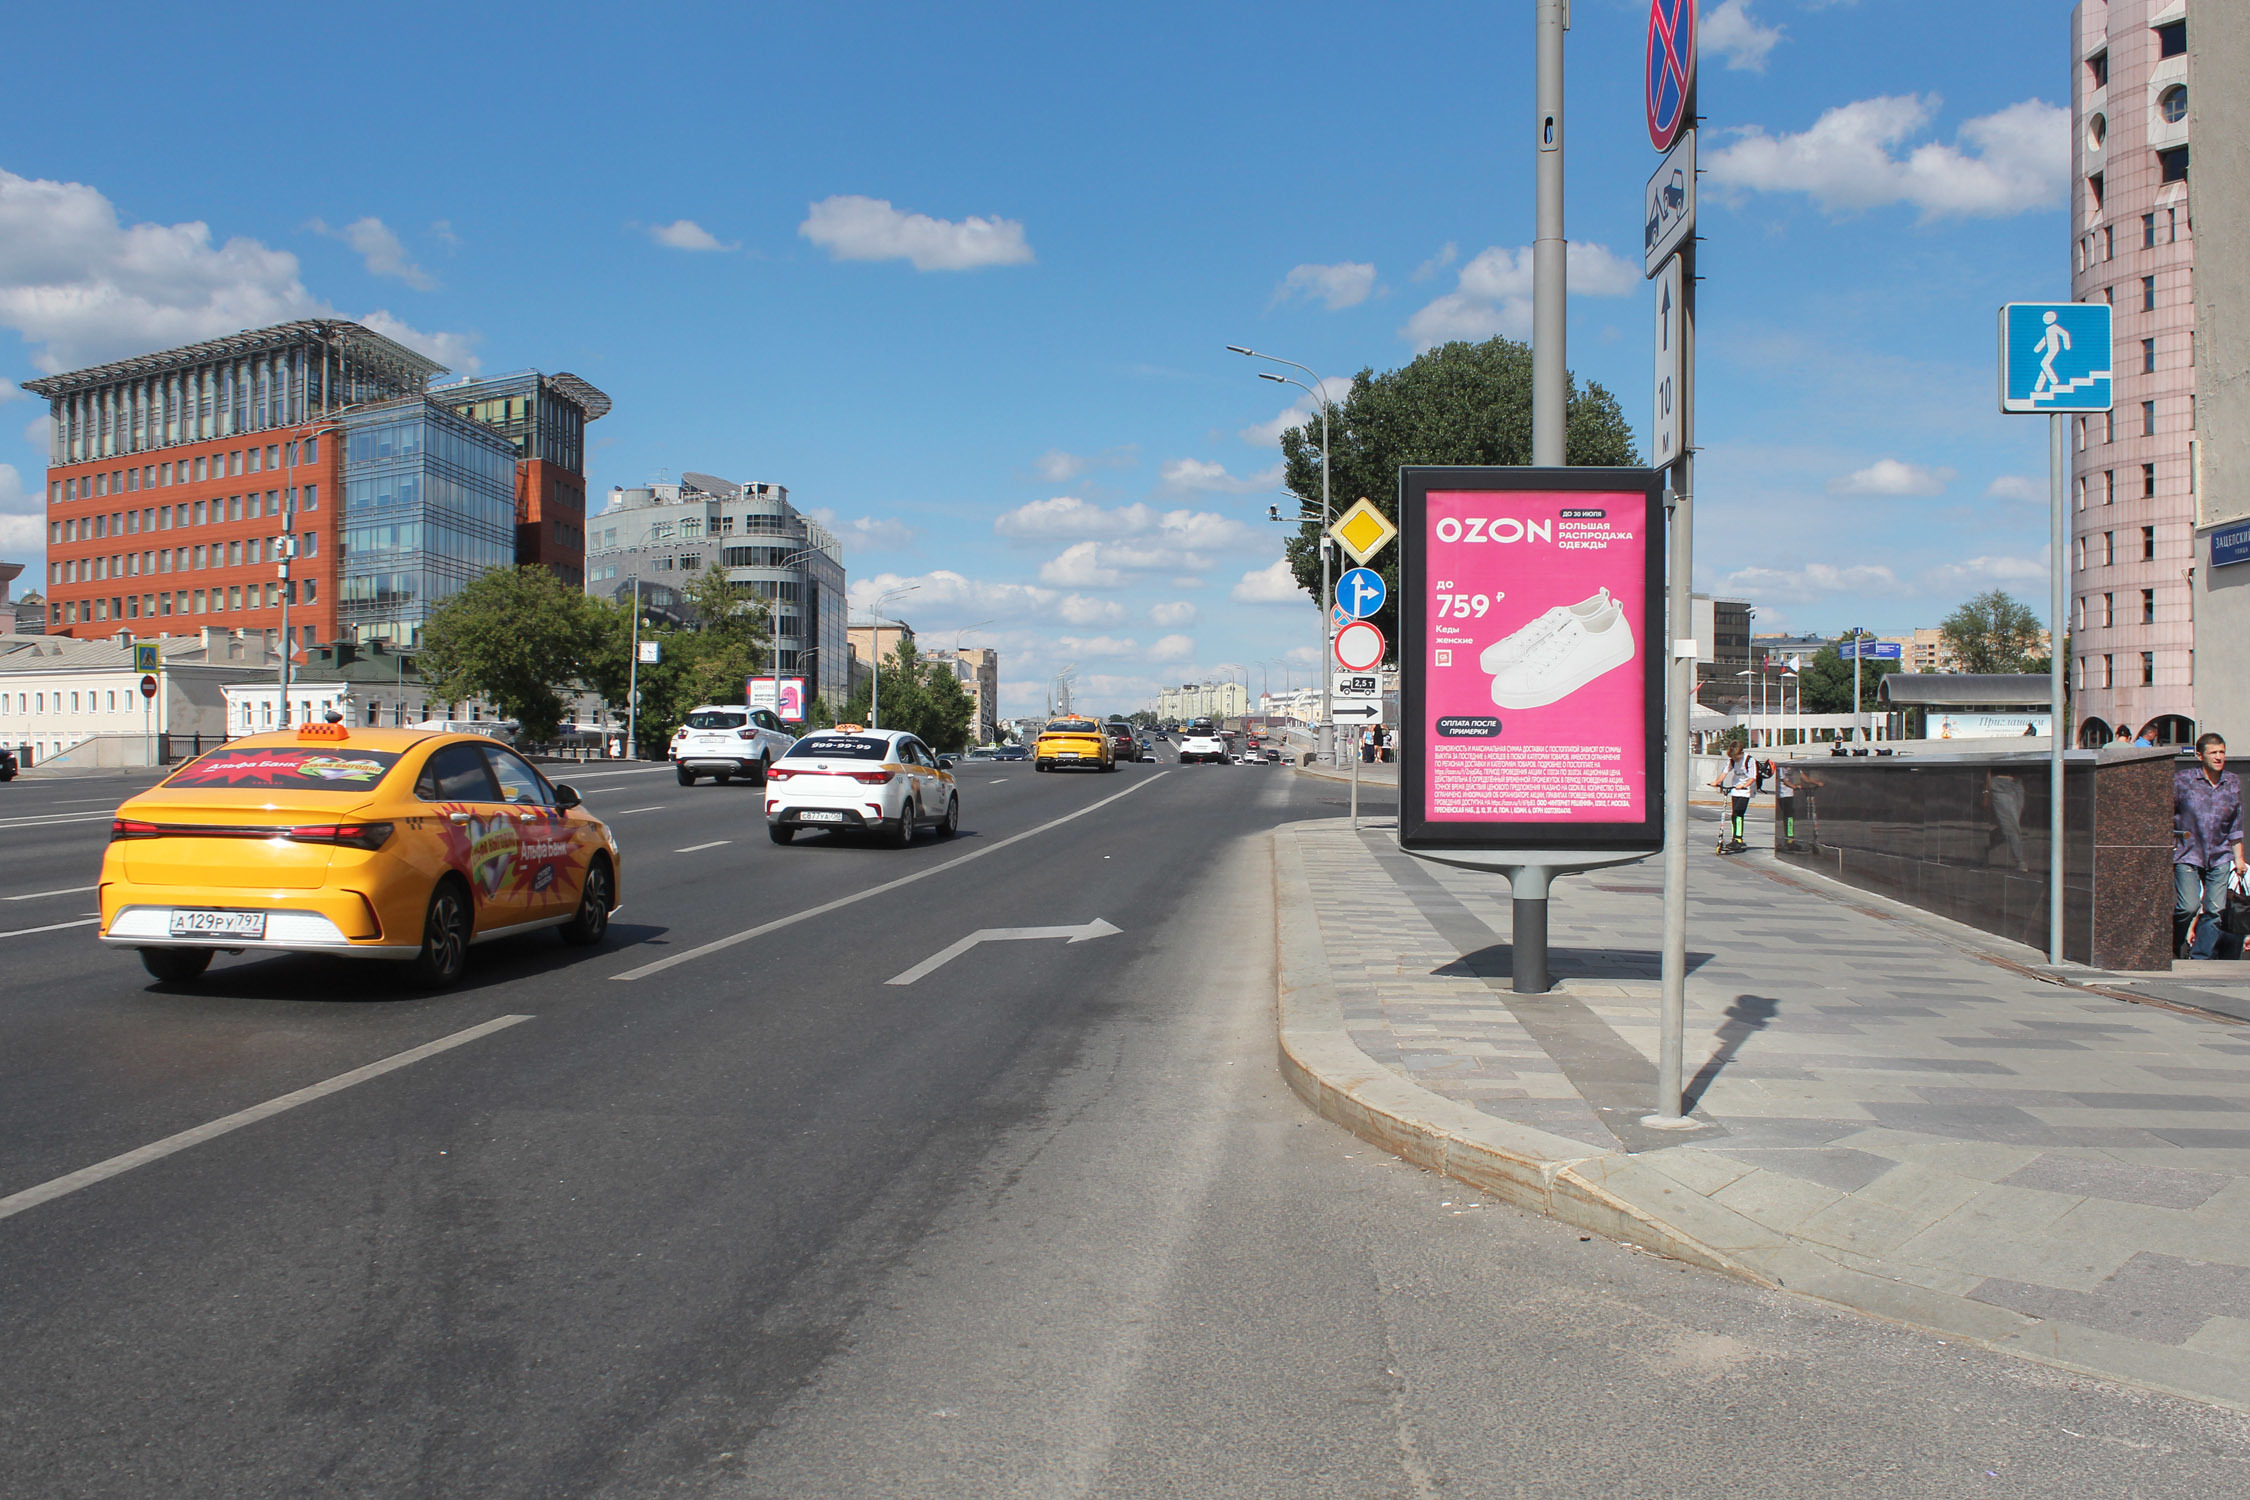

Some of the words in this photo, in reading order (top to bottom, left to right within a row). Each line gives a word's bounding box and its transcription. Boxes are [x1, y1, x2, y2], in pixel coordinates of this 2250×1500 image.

[1659, 376, 1671, 420] 10
[1436, 517, 1551, 543] OZON
[1558, 532, 1633, 540] РАСПРОДАЖА
[1558, 541, 1607, 550] ОДЕЖДЫ
[1436, 594, 1490, 618] 759
[1435, 625, 1460, 634] Кеды
[207, 763, 256, 771] Альфа
[521, 840, 547, 864] Альфа
[548, 837, 567, 857] Банк
[176, 914, 234, 929] А129РУ
[238, 915, 260, 926] 797
